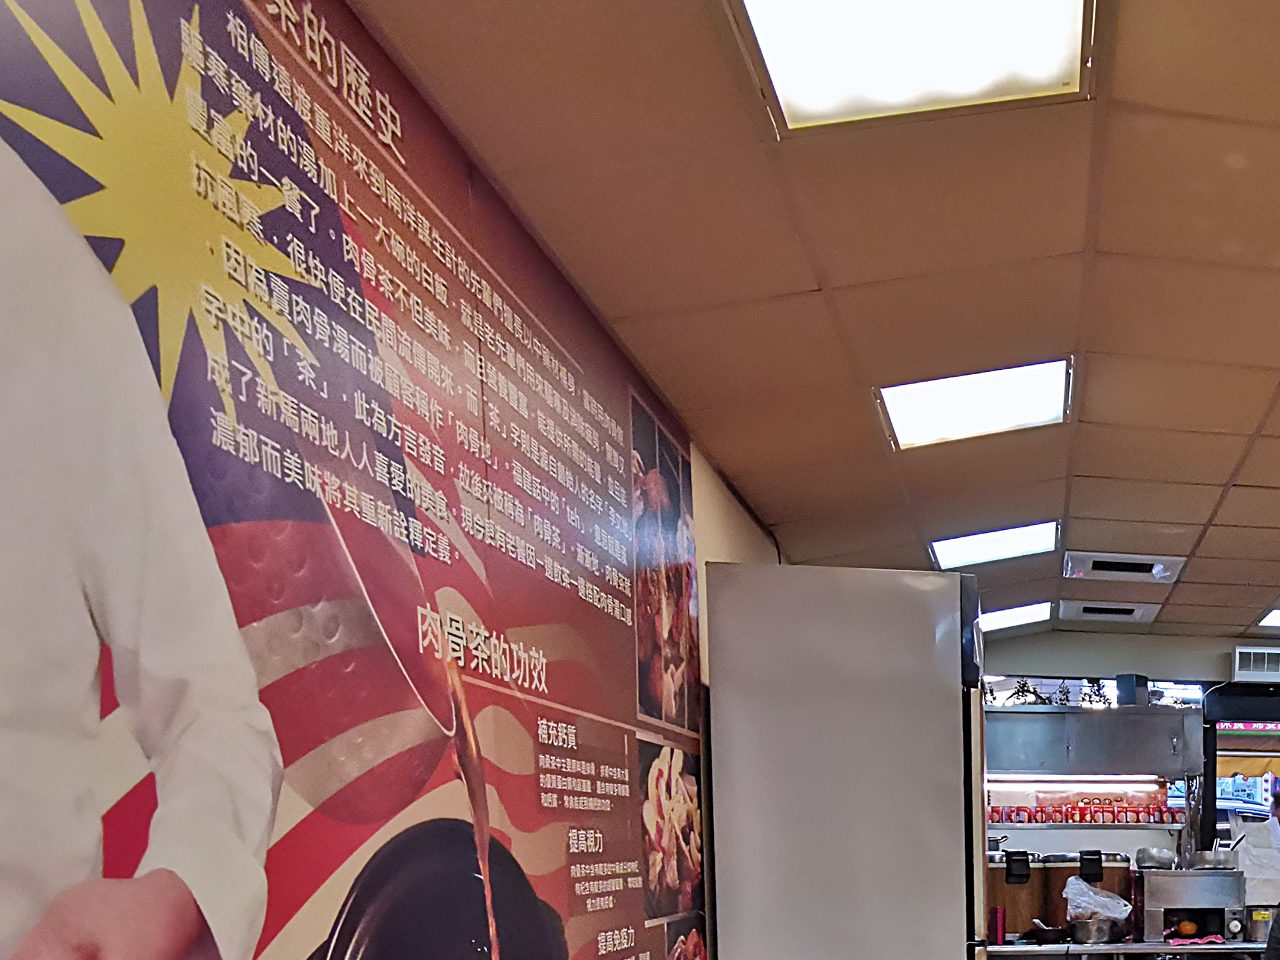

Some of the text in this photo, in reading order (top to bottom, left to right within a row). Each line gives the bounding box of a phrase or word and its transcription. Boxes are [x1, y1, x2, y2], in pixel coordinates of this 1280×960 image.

[417, 602, 548, 694] 肉骨茶的功效
[537, 716, 577, 750] 補充鈣質
[568, 829, 603, 852] 提高視力
[598, 926, 635, 955] 提高免疫力
